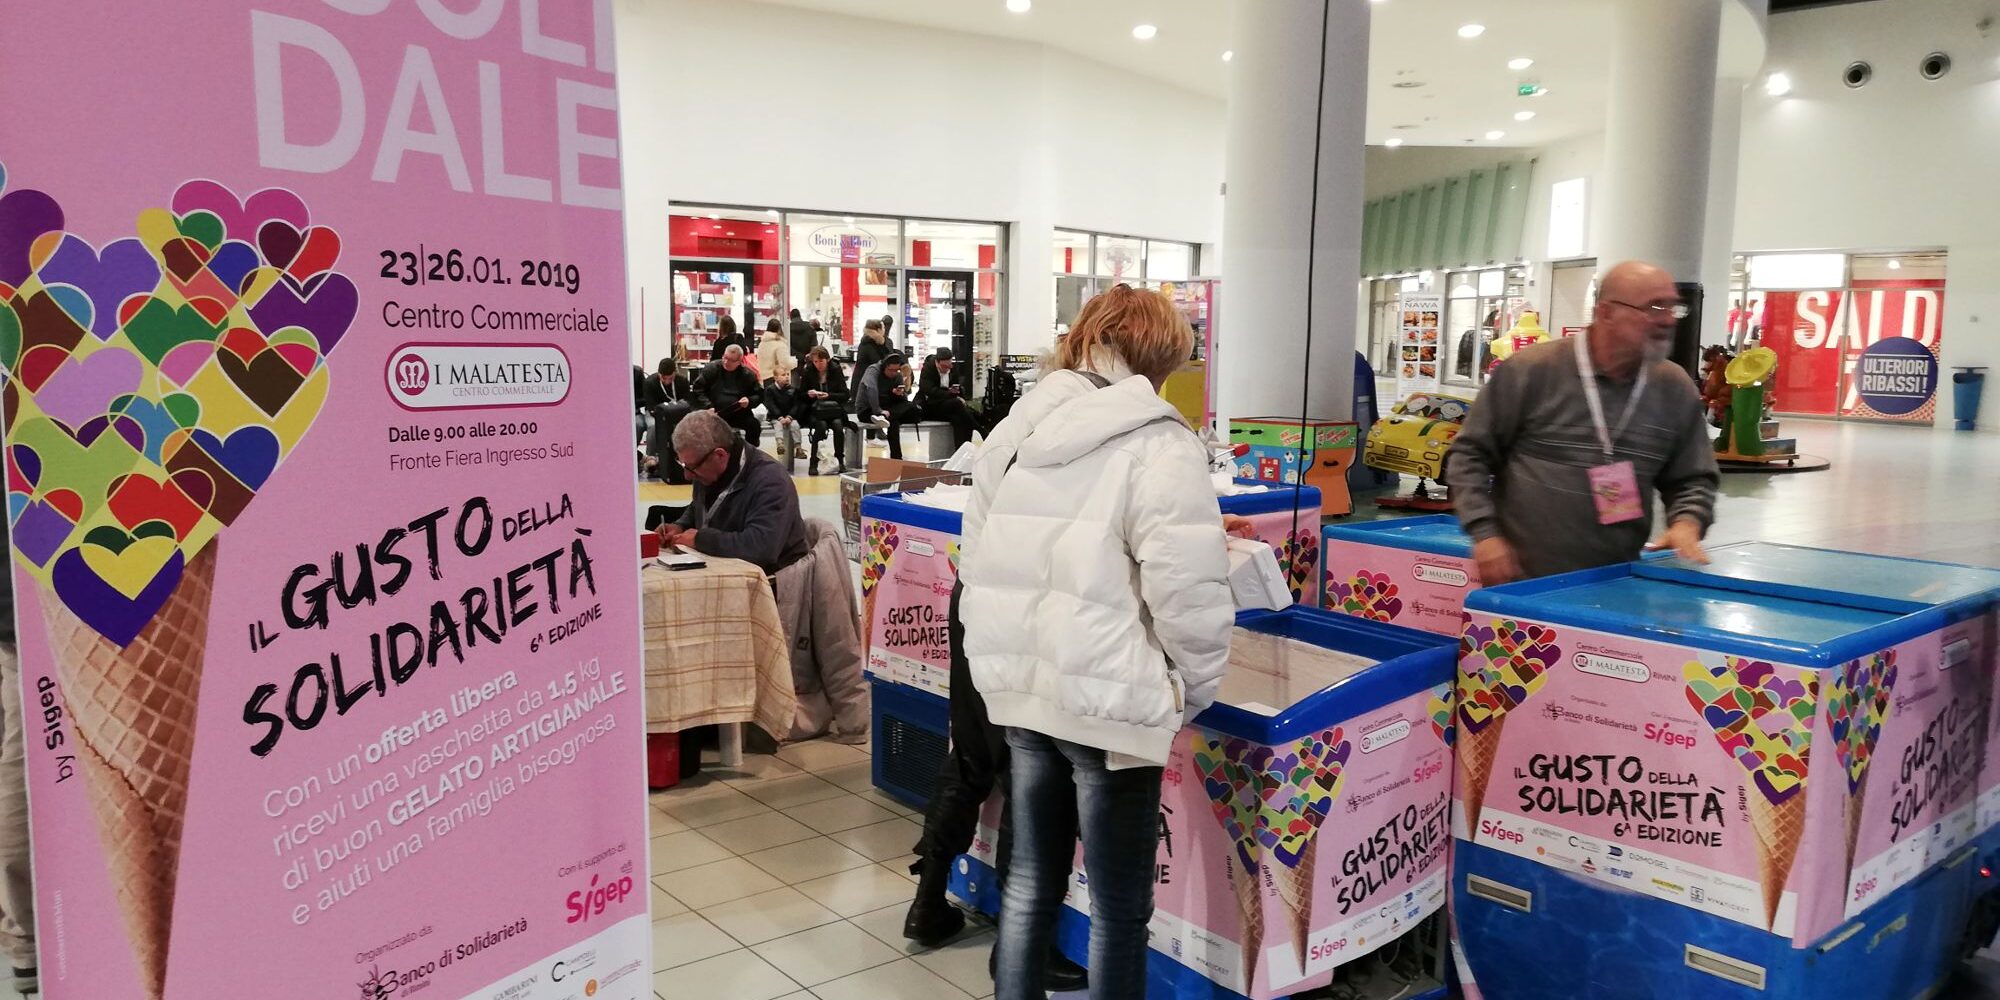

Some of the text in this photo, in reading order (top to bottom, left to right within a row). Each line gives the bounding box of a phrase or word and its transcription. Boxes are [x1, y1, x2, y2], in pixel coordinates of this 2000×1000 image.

[250, 8, 622, 211] DALE
[815, 234, 836, 246] Boni
[850, 235, 871, 248] Boni
[521, 260, 580, 294] 2019
[383, 301, 609, 332] Centro Commerciale
[434, 363, 566, 385] I MALATESTA
[1863, 358, 1928, 375] ULTERIORI
[452, 385, 554, 397] CENTRO COMMERCIALE
[388, 422, 538, 442] Dalle 9.00 alle 20.00
[390, 442, 574, 471] Fronte Fiera Ingresso Sud
[248, 493, 574, 653] IL GUSTO DELLA
[1429, 570, 1466, 582] MALATESTA
[548, 603, 602, 646] EDIZIONE
[888, 605, 934, 626] GUSTO
[242, 527, 598, 758] SOLIDARIETÀ
[1576, 641, 1644, 660] Centro Commerciale
[1594, 660, 1648, 677] MALATESTA
[1652, 672, 1677, 683] RIMINI
[36, 675, 76, 784] by Sigep
[1358, 712, 1403, 734] Centro Commerciale
[1376, 724, 1410, 742] MALATESTA
[1586, 712, 1592, 722] di
[1594, 715, 1638, 732] Solidarietà
[1644, 722, 1696, 750] Sigep
[264, 775, 320, 817] Con
[451, 668, 518, 719] libera
[273, 655, 602, 856] ricevi una vaschetta da 1,5 kg
[1900, 698, 1960, 785] GUSTO
[282, 671, 628, 892] di buon GELATO ARTIGIANALE
[1414, 760, 1444, 784] Sigep
[1514, 754, 1698, 788] IL GUSTO DELLA
[1376, 788, 1382, 797] di
[1518, 785, 1726, 828] SOLIDARIETÀ
[1738, 786, 1748, 812] Sigep
[291, 712, 616, 926] e aiuti una famiglia bisognosa
[1481, 820, 1524, 845] Sigep
[1342, 804, 1417, 876] GUSTO
[1420, 791, 1445, 820] DELLA
[1638, 824, 1723, 848] EDIZIONE
[558, 863, 576, 878] Con
[584, 848, 617, 871] supporto
[1263, 864, 1274, 888] Sigep
[566, 874, 633, 924] Sigep
[354, 931, 418, 964] Organizzato
[439, 950, 453, 968] di
[456, 917, 528, 960] Solidarietà
[1310, 934, 1348, 961] Sigep
